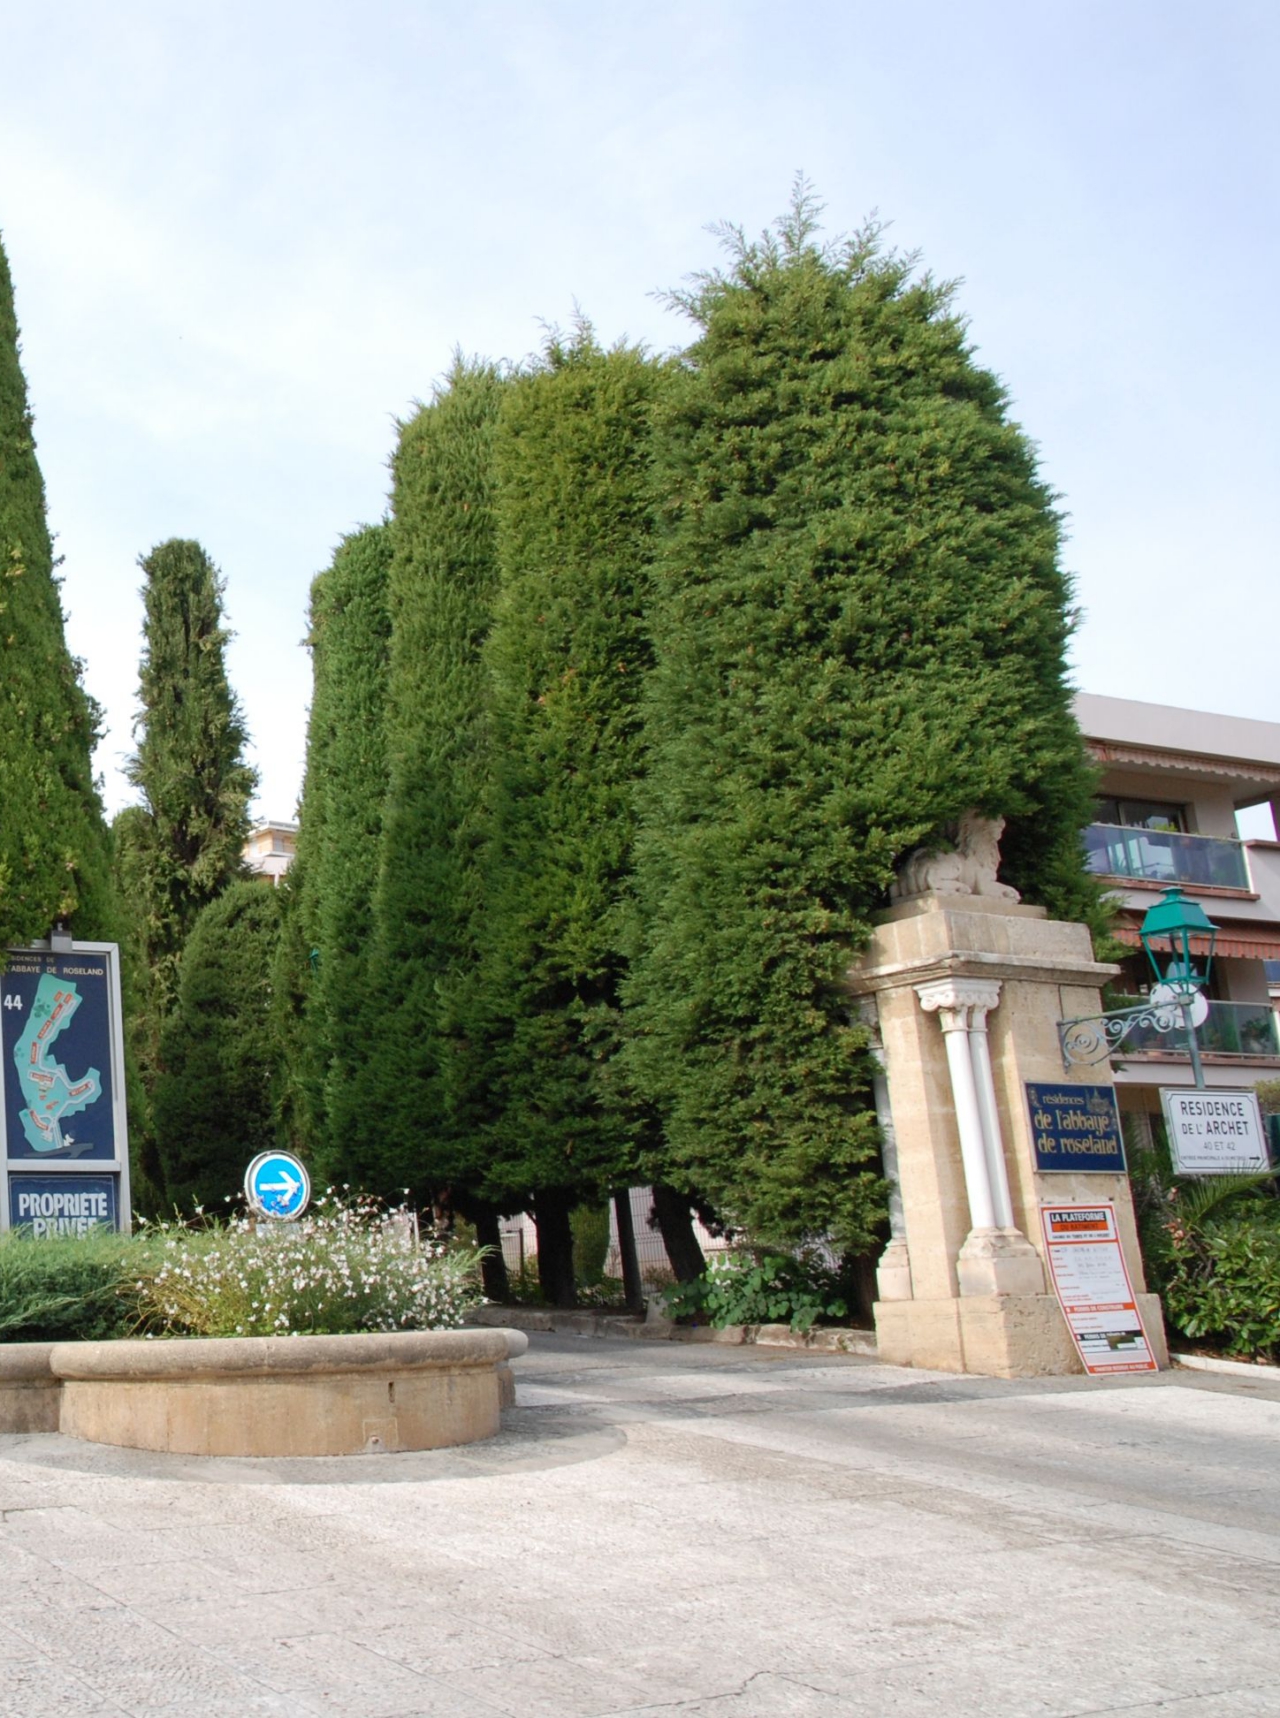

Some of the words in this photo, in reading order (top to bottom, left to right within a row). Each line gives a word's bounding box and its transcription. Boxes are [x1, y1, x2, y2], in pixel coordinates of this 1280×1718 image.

[46, 966, 57, 974] DE
[63, 967, 104, 976] ROSELAND
[3, 994, 23, 1010] 44
[1042, 1093, 1085, 1105] résidences
[1180, 1101, 1244, 1116] RESIDENCE
[1034, 1109, 1053, 1130] de
[1055, 1109, 1109, 1137] l'abbaye
[1181, 1123, 1194, 1135] DE
[1206, 1121, 1249, 1135] ARCHET
[1037, 1132, 1057, 1153] de
[1060, 1134, 1119, 1155] roseland
[1203, 1141, 1213, 1150] 40
[1214, 1141, 1224, 1150] ET
[1226, 1141, 1236, 1151] 42
[18, 1192, 108, 1217] PROPRIÉTÉ
[1051, 1213, 1061, 1223] LA
[1061, 1212, 1105, 1222] PLATEFORME
